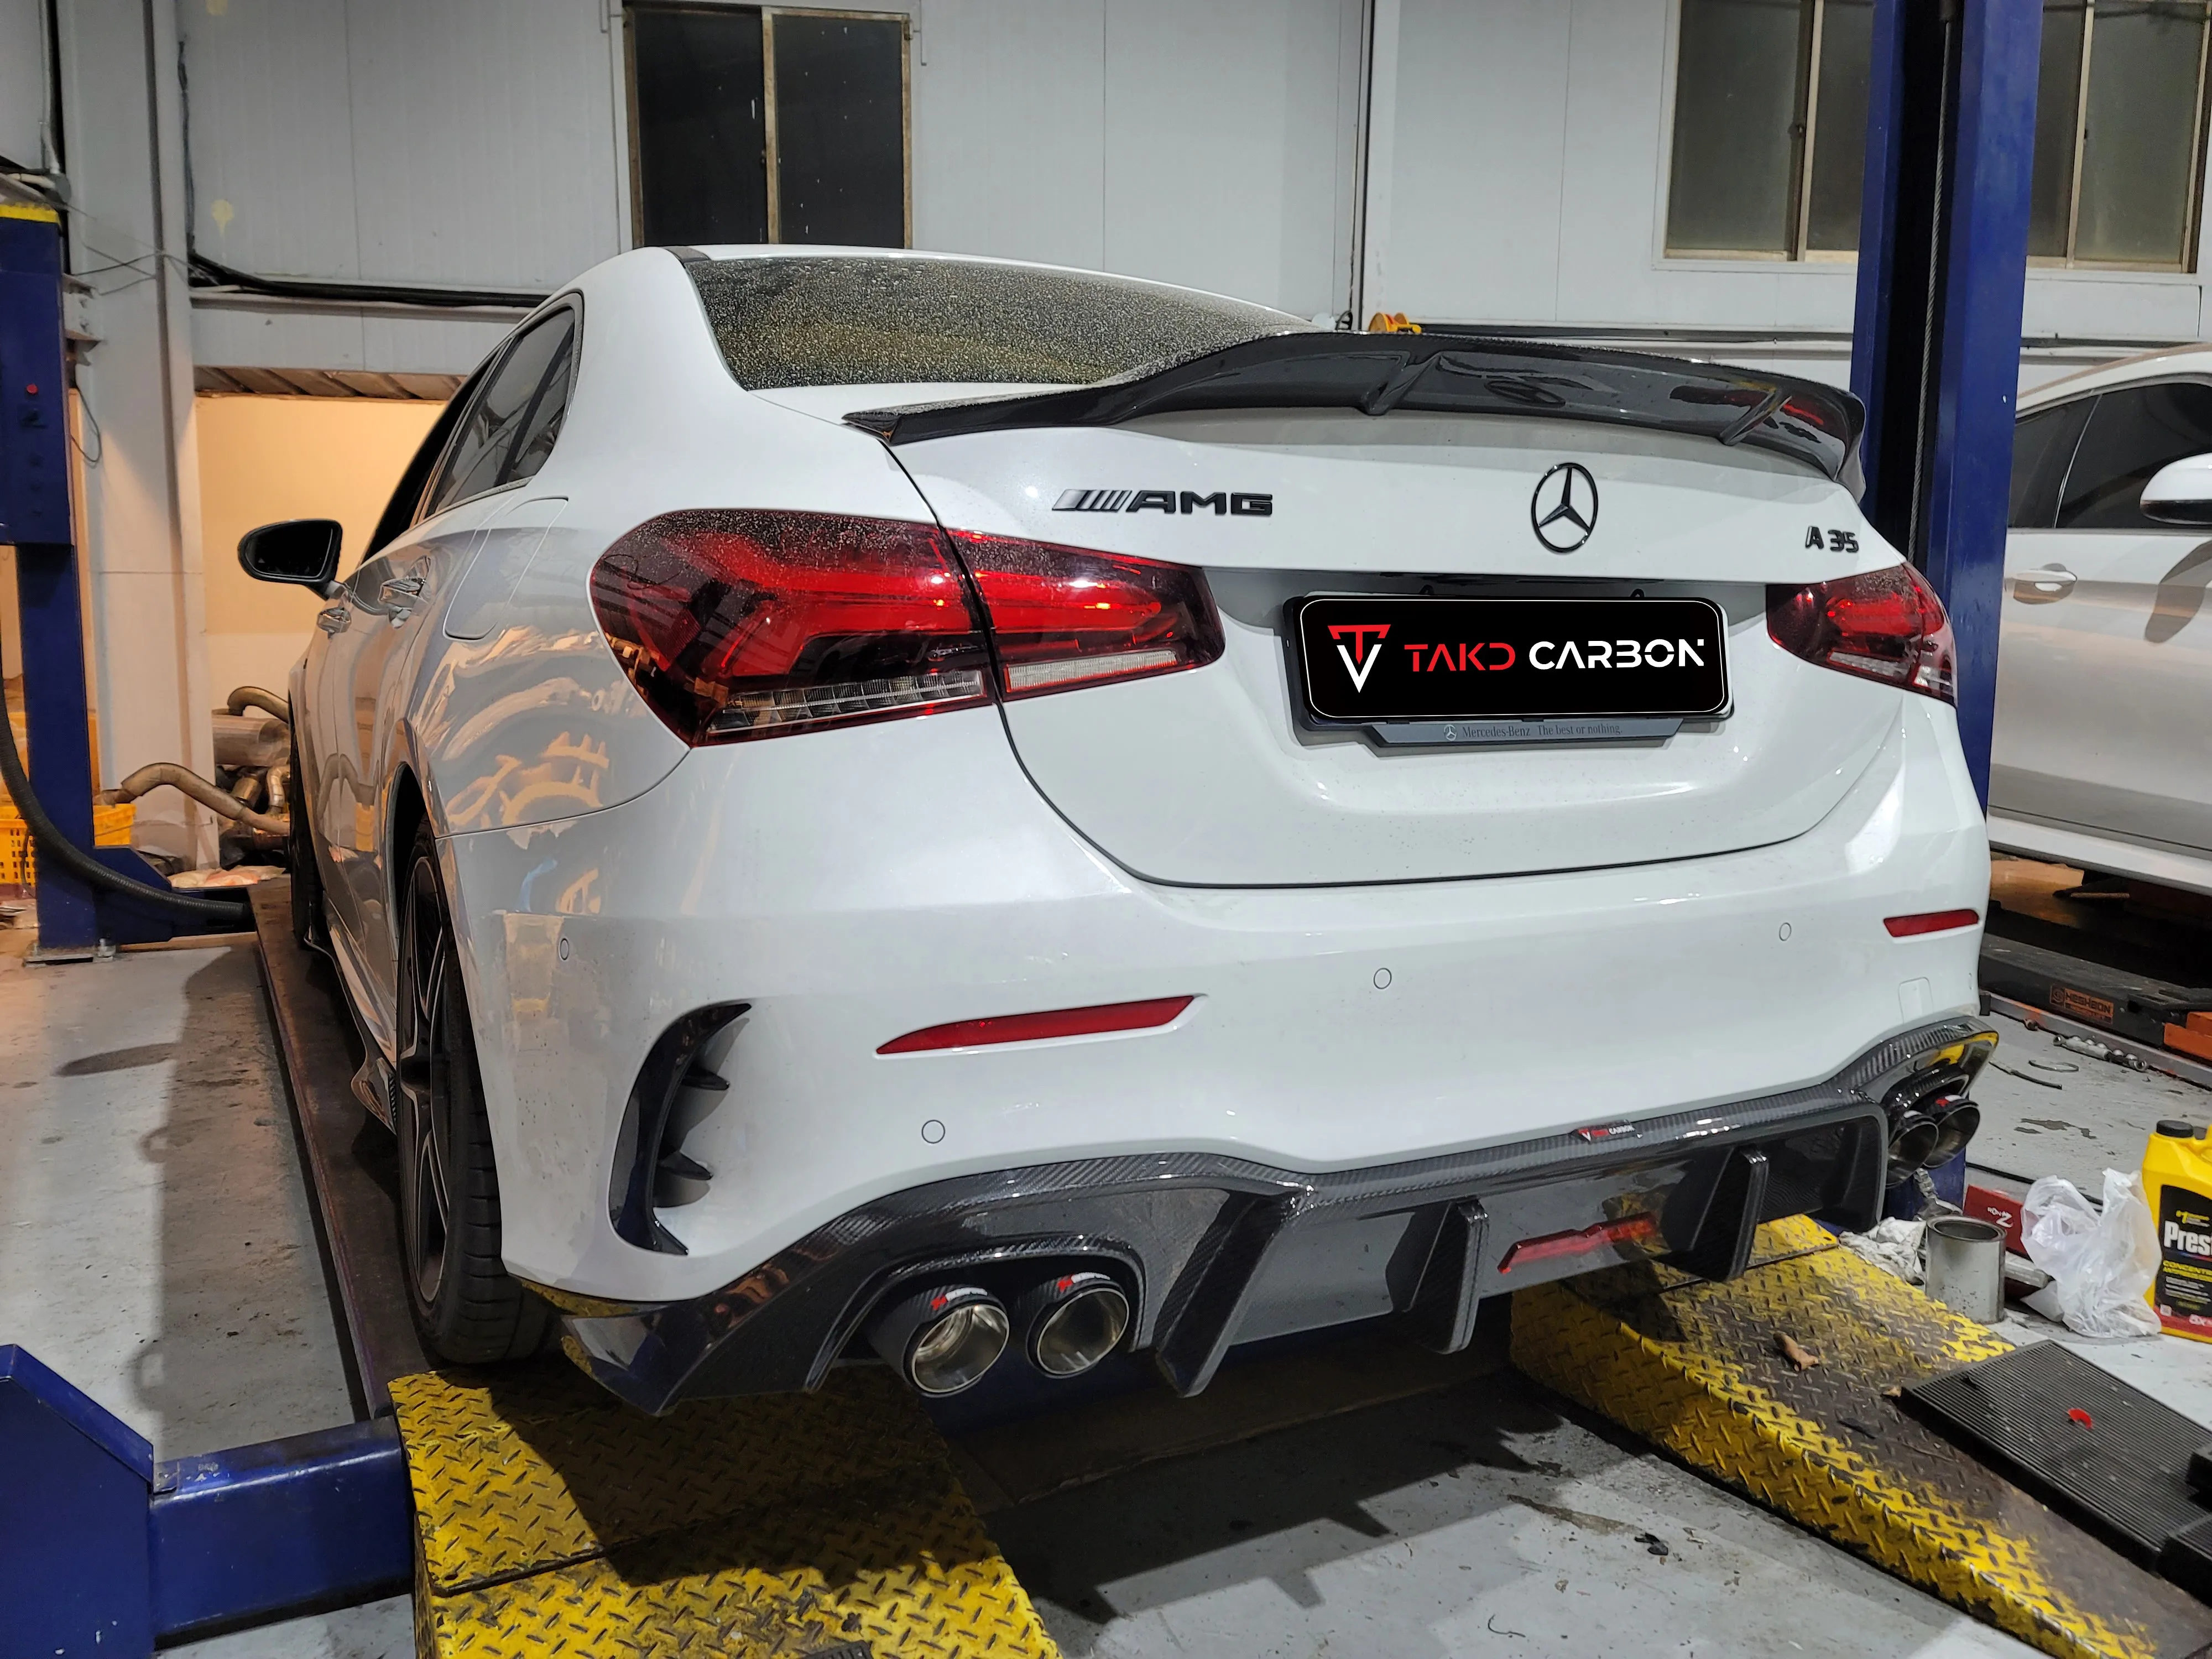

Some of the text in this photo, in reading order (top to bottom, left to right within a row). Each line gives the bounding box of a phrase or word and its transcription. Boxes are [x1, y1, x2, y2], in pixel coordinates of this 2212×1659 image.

[1125, 490, 1272, 515] AMG
[1805, 526, 1859, 553] A 35
[1462, 723, 1623, 738] Mercedes-Benz The best or nothing.
[2164, 1220, 2212, 1257] Pres
